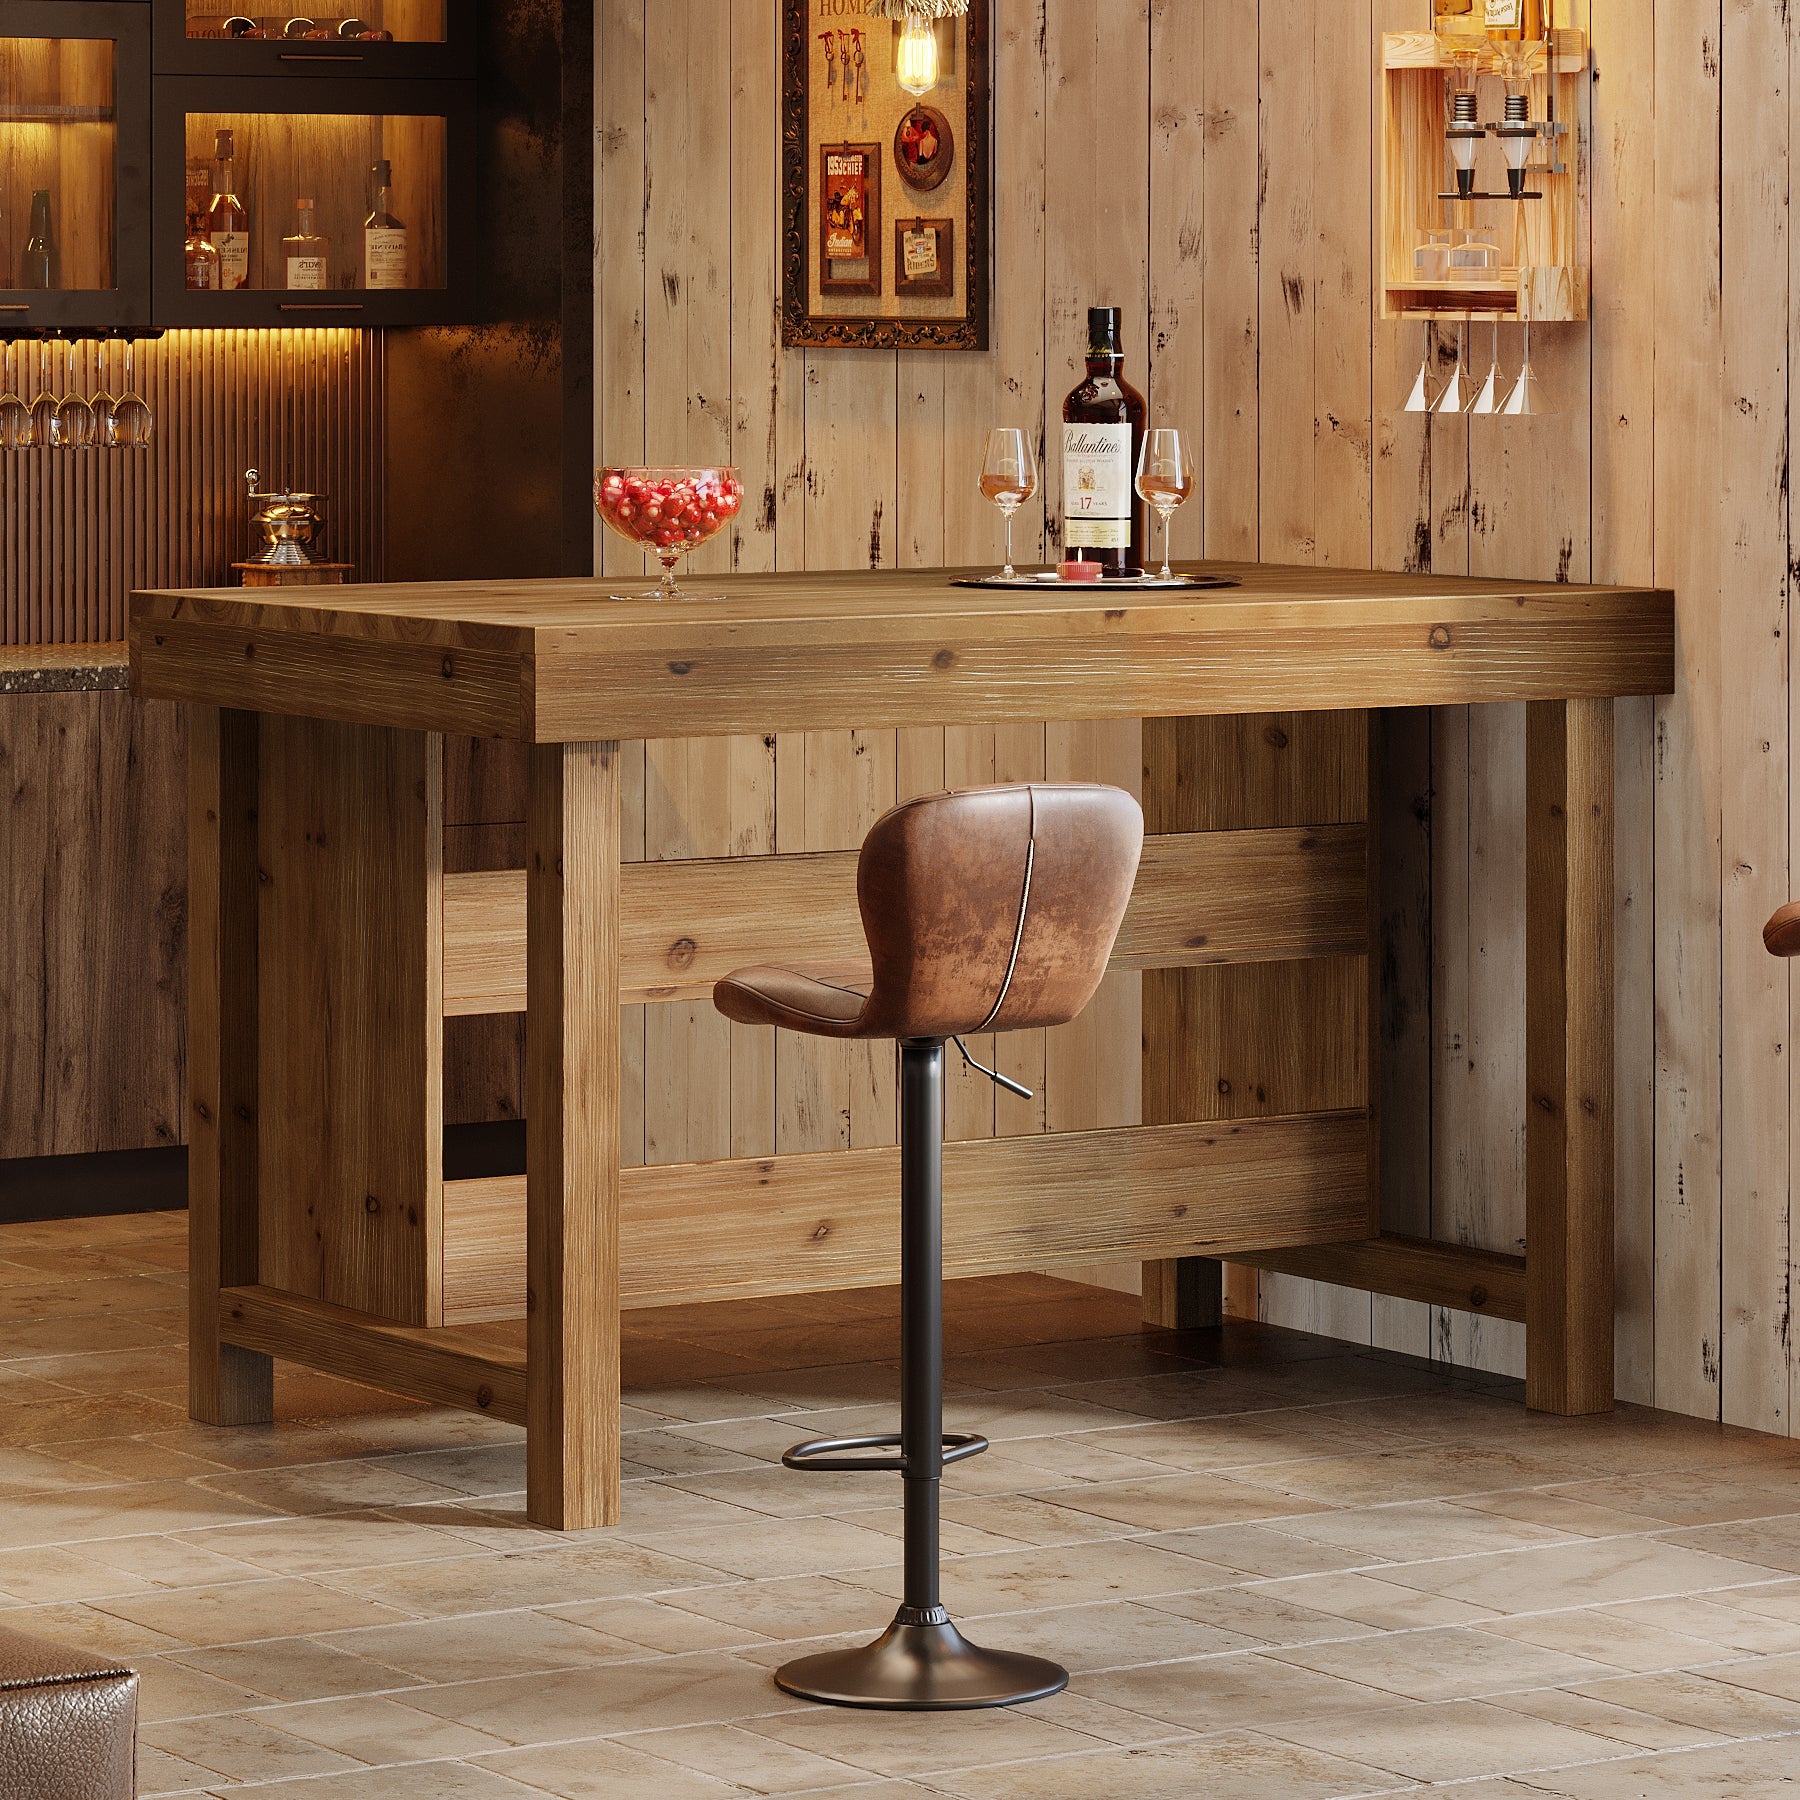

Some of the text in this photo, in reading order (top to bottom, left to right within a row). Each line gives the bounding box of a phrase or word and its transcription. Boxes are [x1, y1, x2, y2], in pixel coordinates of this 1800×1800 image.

[819, 0, 867, 16] HOM
[827, 156, 863, 175] 1953 CHIEF
[827, 232, 853, 248] Indian
[906, 257, 935, 271] RIDERS
[1064, 429, 1121, 454] Ballantine's
[1080, 496, 1092, 510] 17
